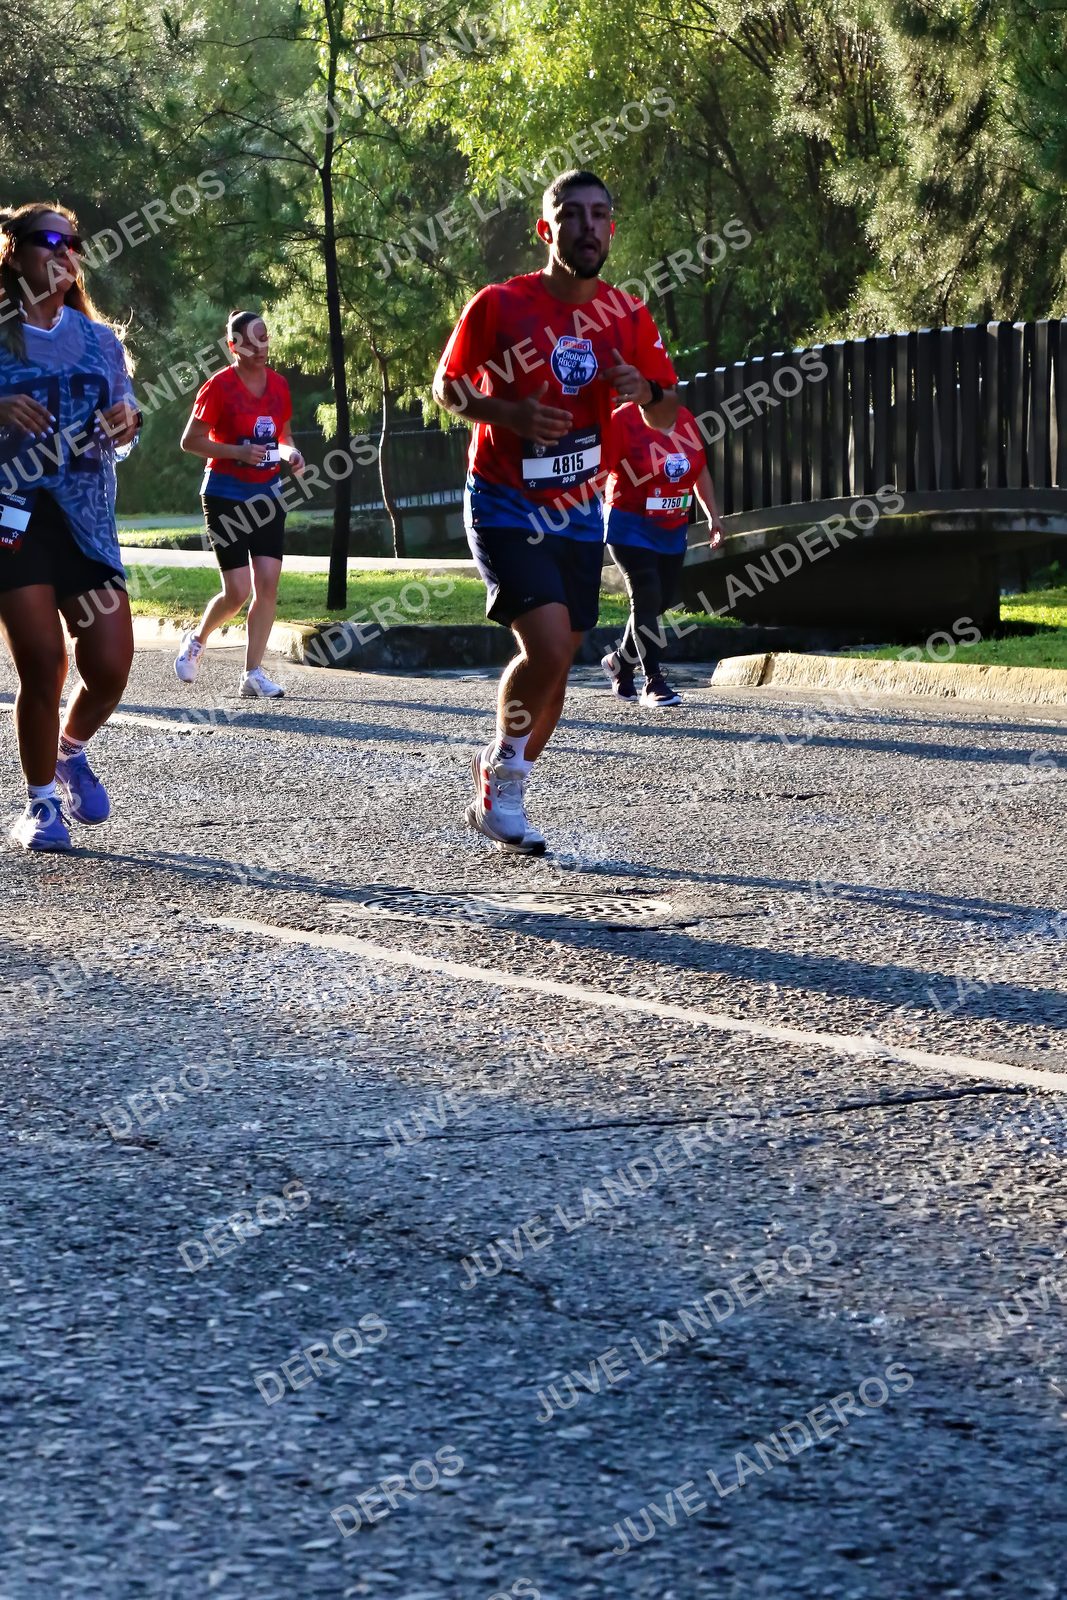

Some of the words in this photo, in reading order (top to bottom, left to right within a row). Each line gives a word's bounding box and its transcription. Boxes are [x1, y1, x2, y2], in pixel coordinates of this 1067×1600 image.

[562, 351, 588, 363] Global
[552, 452, 584, 475] 4815
[662, 497, 682, 509] 2750
[1, 536, 14, 545] 10K
